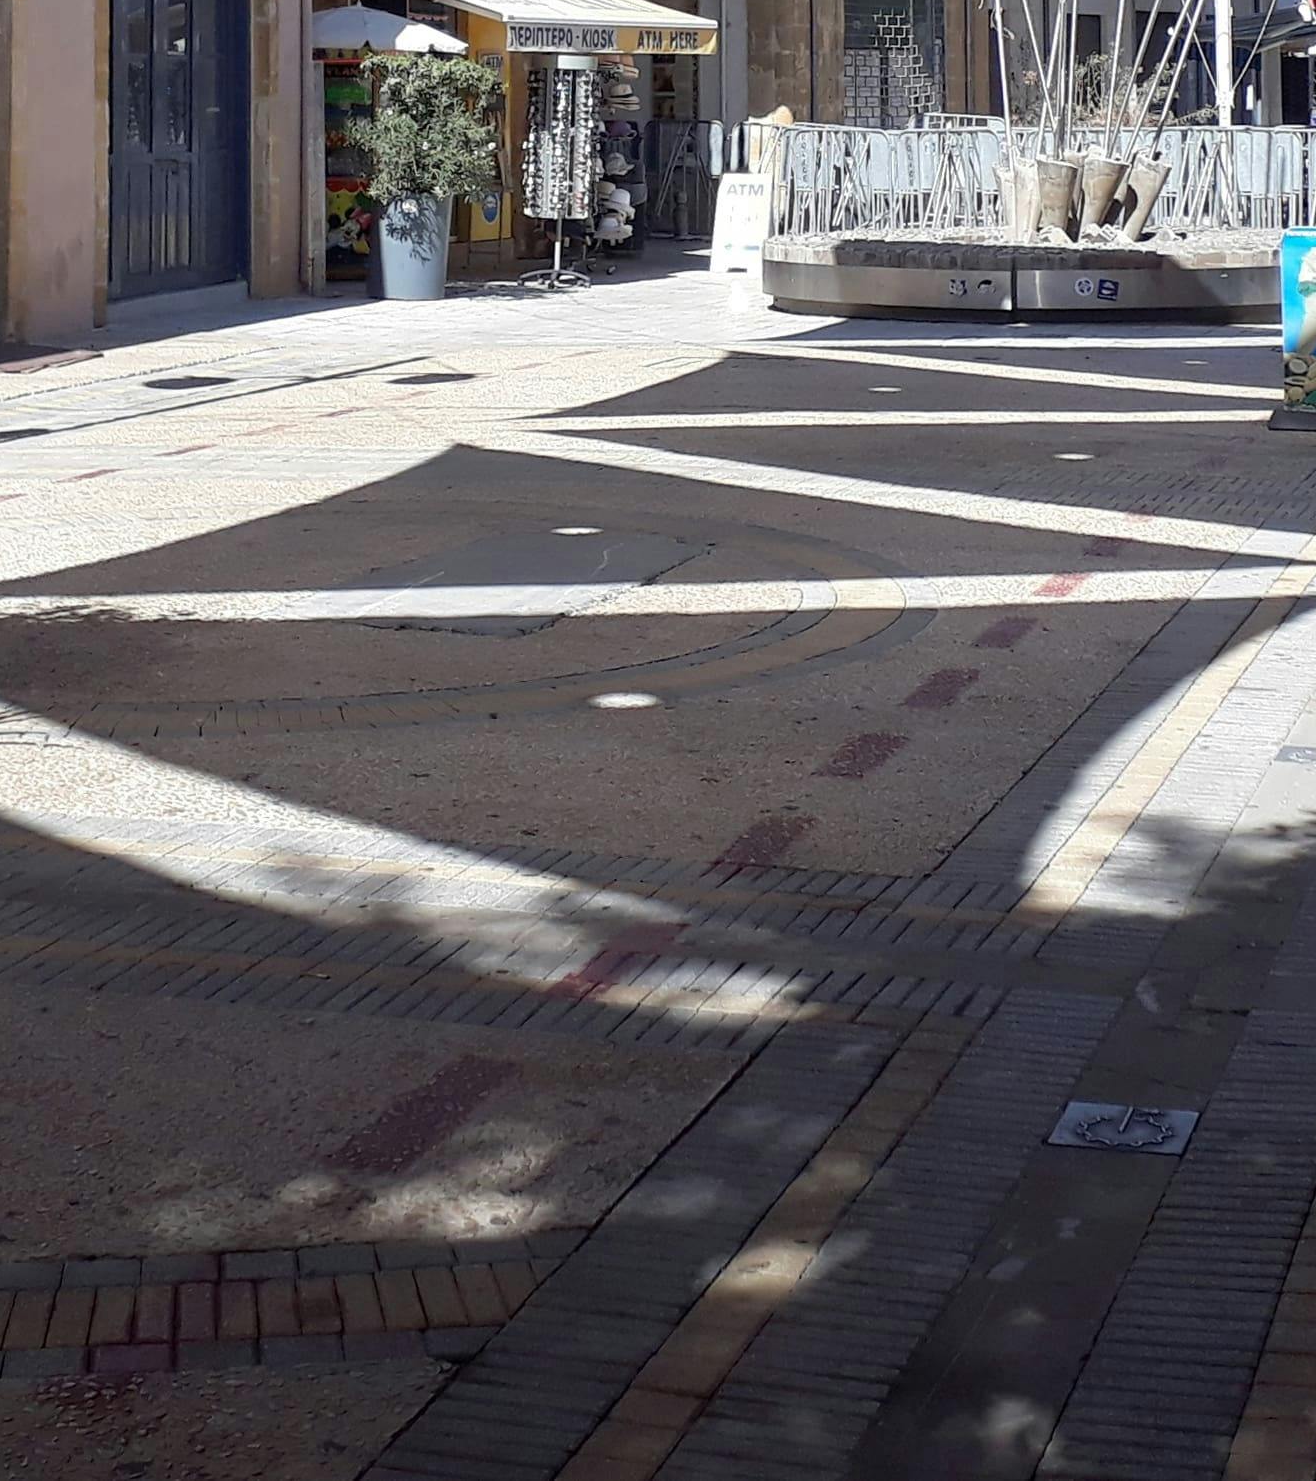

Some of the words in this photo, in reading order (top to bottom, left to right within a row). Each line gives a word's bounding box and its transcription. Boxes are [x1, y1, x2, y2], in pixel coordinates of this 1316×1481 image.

[509, 25, 572, 48] ΠΕΡΙΠΤΕΡΟ
[582, 29, 614, 49] KIOSK
[637, 30, 663, 50] ATM
[669, 31, 698, 50] HERE
[727, 183, 764, 197] ATM
